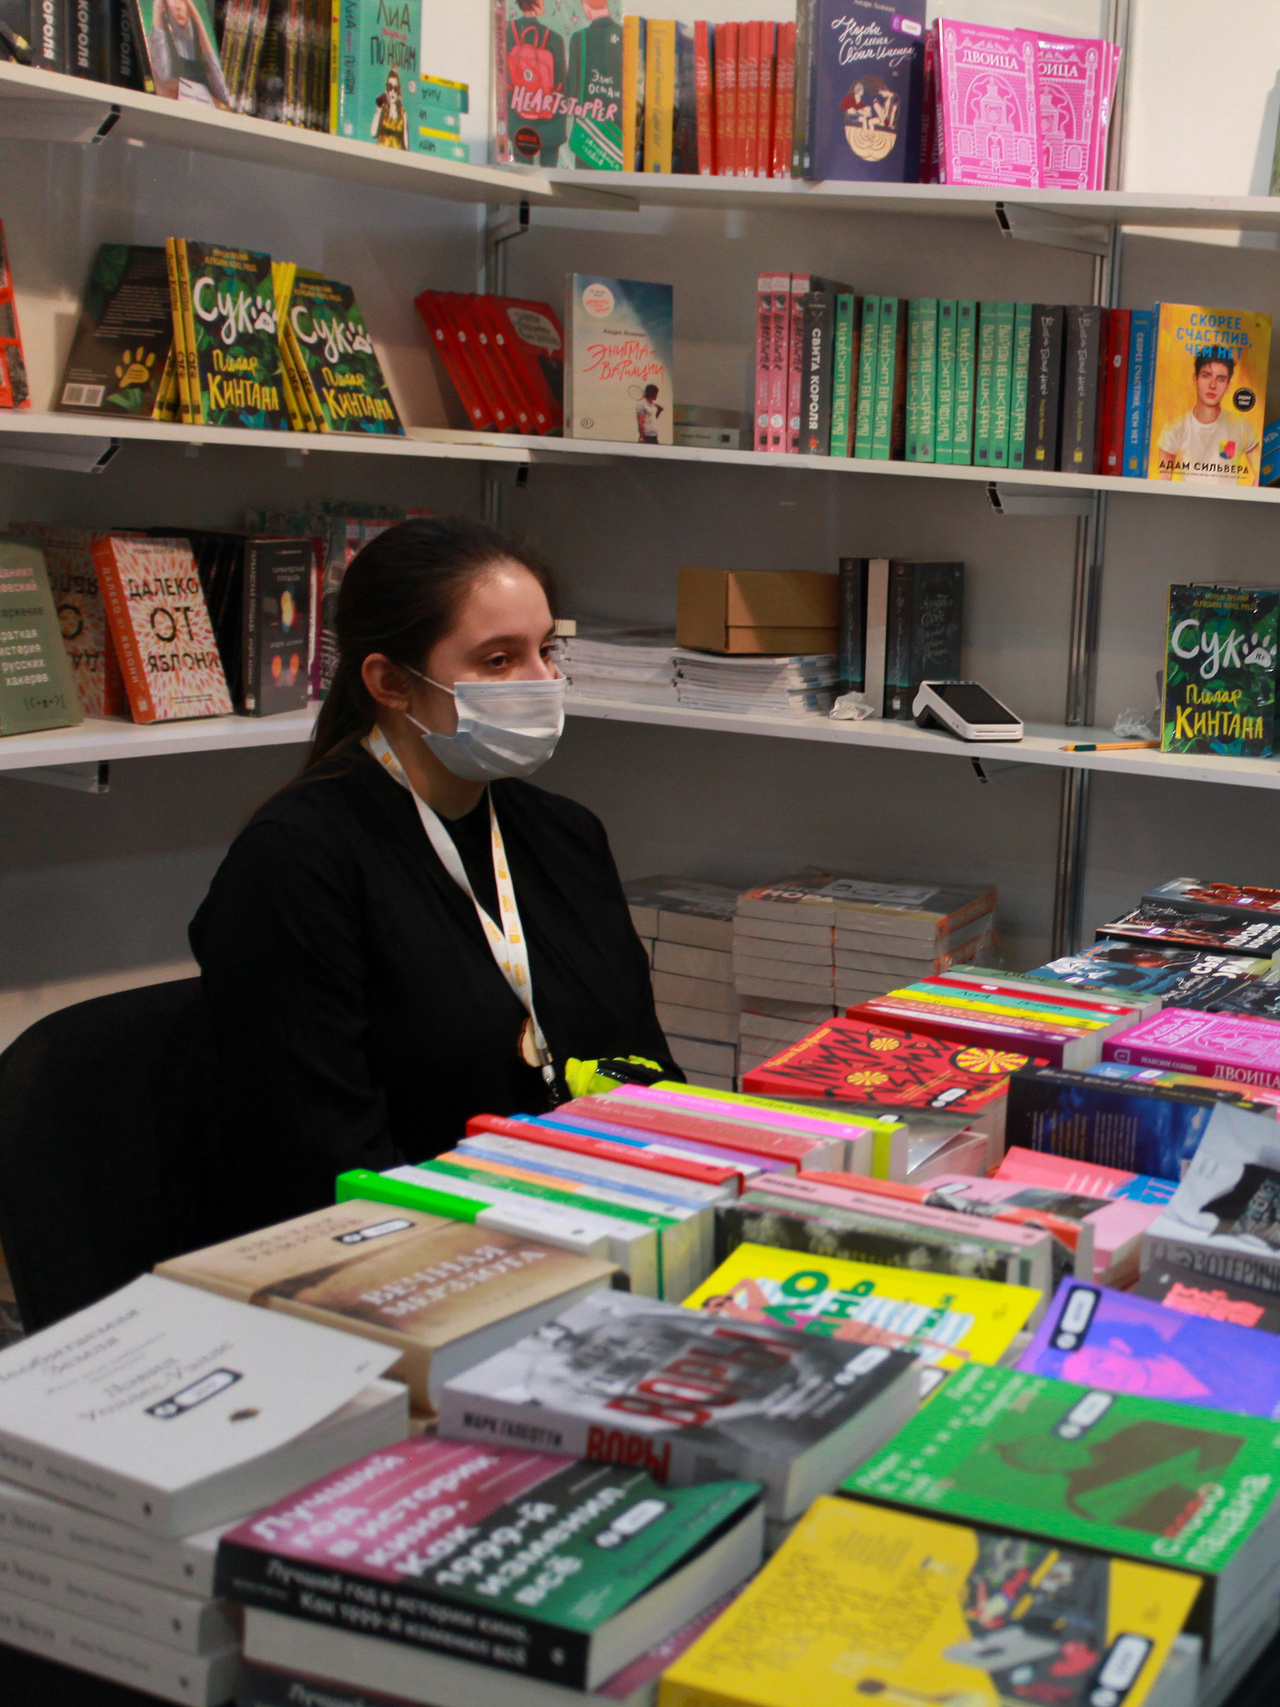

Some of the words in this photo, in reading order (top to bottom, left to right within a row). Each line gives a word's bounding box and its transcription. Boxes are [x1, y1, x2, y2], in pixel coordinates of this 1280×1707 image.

[962, 49, 1019, 71] ДВОИЦА
[510, 86, 619, 122] HEARTSTOPPER
[1176, 327, 1253, 348] СЧАСТЛИВ,
[1189, 313, 1243, 330] СКОРЕЕ
[810, 326, 822, 372] СВИТА
[1184, 344, 1214, 359] ЧЕМ
[1217, 345, 1244, 360] НЕТ
[808, 375, 820, 430] КОРОЛЯ
[1158, 460, 1191, 472] АДАМ
[1193, 462, 1249, 475] СИЛЬВЕРА
[128, 577, 199, 600] ДАЛЕКО
[102, 566, 121, 614] ДАЛЕКО
[120, 633, 139, 684] ЯБЛОНИ
[150, 606, 195, 643] ОТ
[2, 658, 46, 674] русских
[5, 672, 50, 687] хакеров
[150, 651, 219, 674] ЯБЛОНИ
[1185, 683, 1243, 708] Пилар
[1175, 705, 1265, 741] КИНТАНА
[1141, 1056, 1170, 1069] МАКСИМ
[1172, 1062, 1197, 1073] СОНИН
[360, 1244, 508, 1306] ВЕЧНАЯ
[381, 1248, 548, 1318] МЕРЗЛОТА
[462, 1412, 497, 1437] МАРК
[499, 1419, 563, 1447] ГАЛЕОТТИ
[586, 1424, 672, 1485] ВОРЫ
[251, 1453, 407, 1540] Лучший
[355, 1454, 500, 1538] истории
[291, 1505, 369, 1549] год
[435, 1500, 560, 1587] 1999-й
[476, 1484, 627, 1597] изменил
[394, 1522, 480, 1578] Как
[266, 1561, 342, 1595] Лучший
[396, 1587, 476, 1628] истории
[300, 1592, 333, 1615] Как
[337, 1601, 402, 1634] 1999-й
[404, 1619, 489, 1653] изменил
